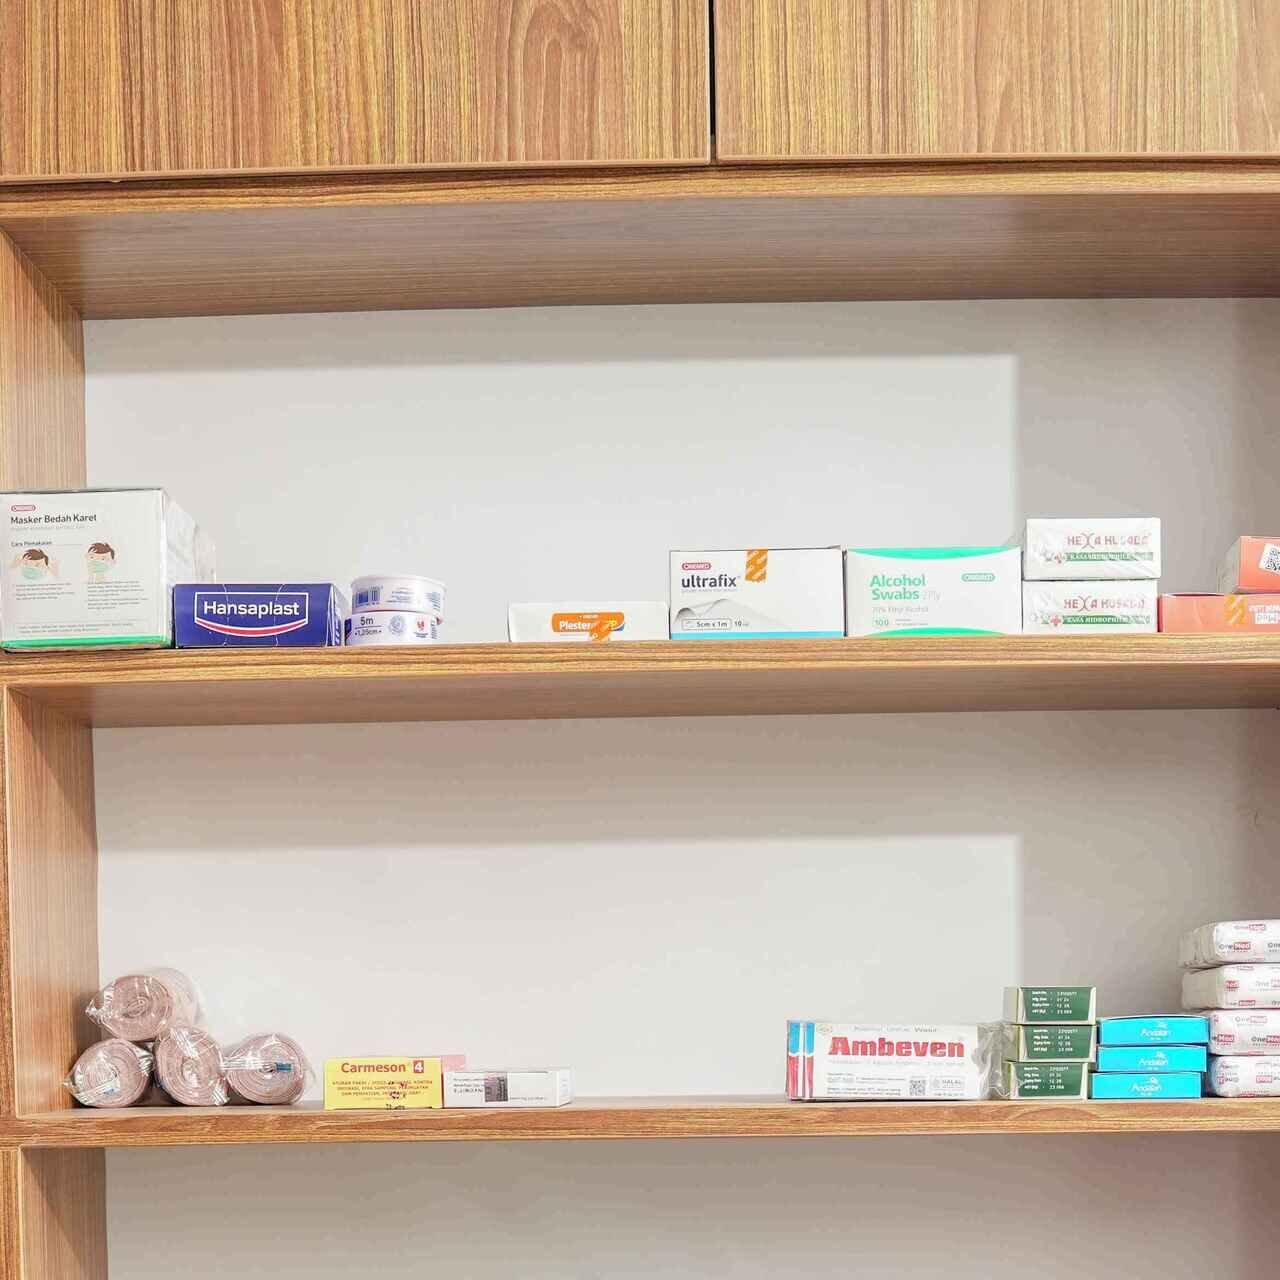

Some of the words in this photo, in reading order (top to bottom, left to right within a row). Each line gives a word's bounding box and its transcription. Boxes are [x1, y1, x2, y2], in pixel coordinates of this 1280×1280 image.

[10, 515, 42, 525] Masker
[44, 515, 72, 524] Bedah
[73, 514, 97, 523] Karet
[681, 574, 737, 589] ultrafix
[871, 575, 926, 588] Alcohol
[872, 588, 920, 602] Swabs
[204, 601, 300, 619] Hansaplast
[828, 1036, 965, 1058] Ambeven
[341, 1062, 407, 1073] Carmeson
[414, 1061, 424, 1073] 4
